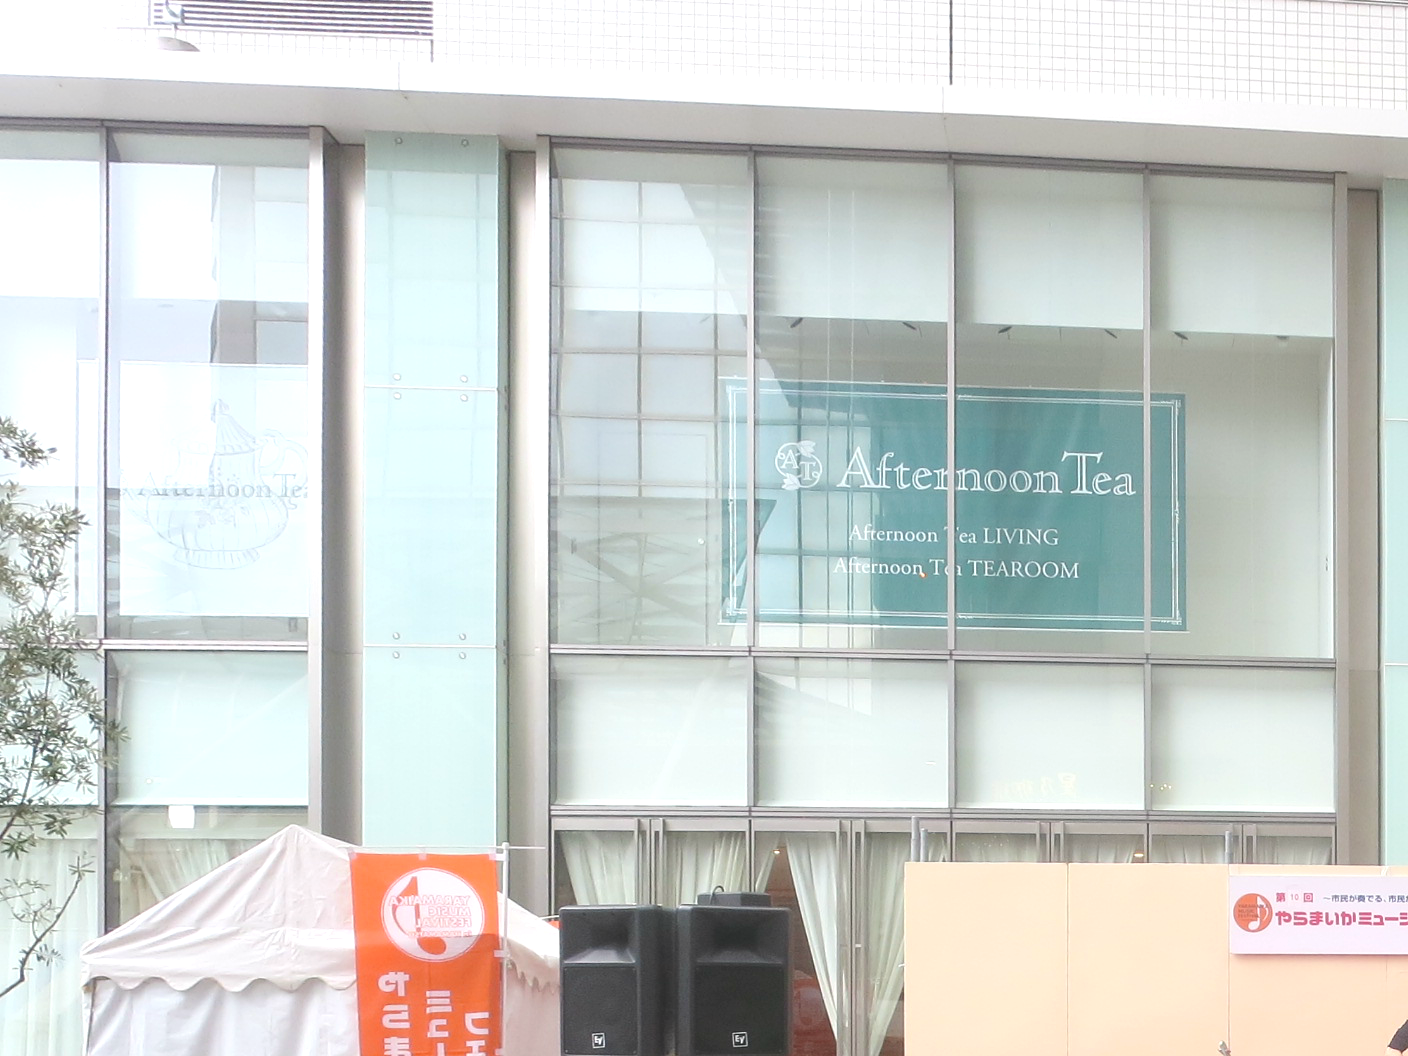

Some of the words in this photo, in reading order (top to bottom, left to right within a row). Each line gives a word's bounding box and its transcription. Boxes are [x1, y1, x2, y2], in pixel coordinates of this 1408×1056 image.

[836, 446, 1062, 494] Afternoon
[1061, 450, 1136, 496] Tea
[848, 524, 938, 543] Afternoon
[943, 527, 977, 544] ea
[983, 527, 1059, 546] LIVING
[833, 556, 923, 575] Afternoon
[967, 559, 1080, 579] TEAROOM
